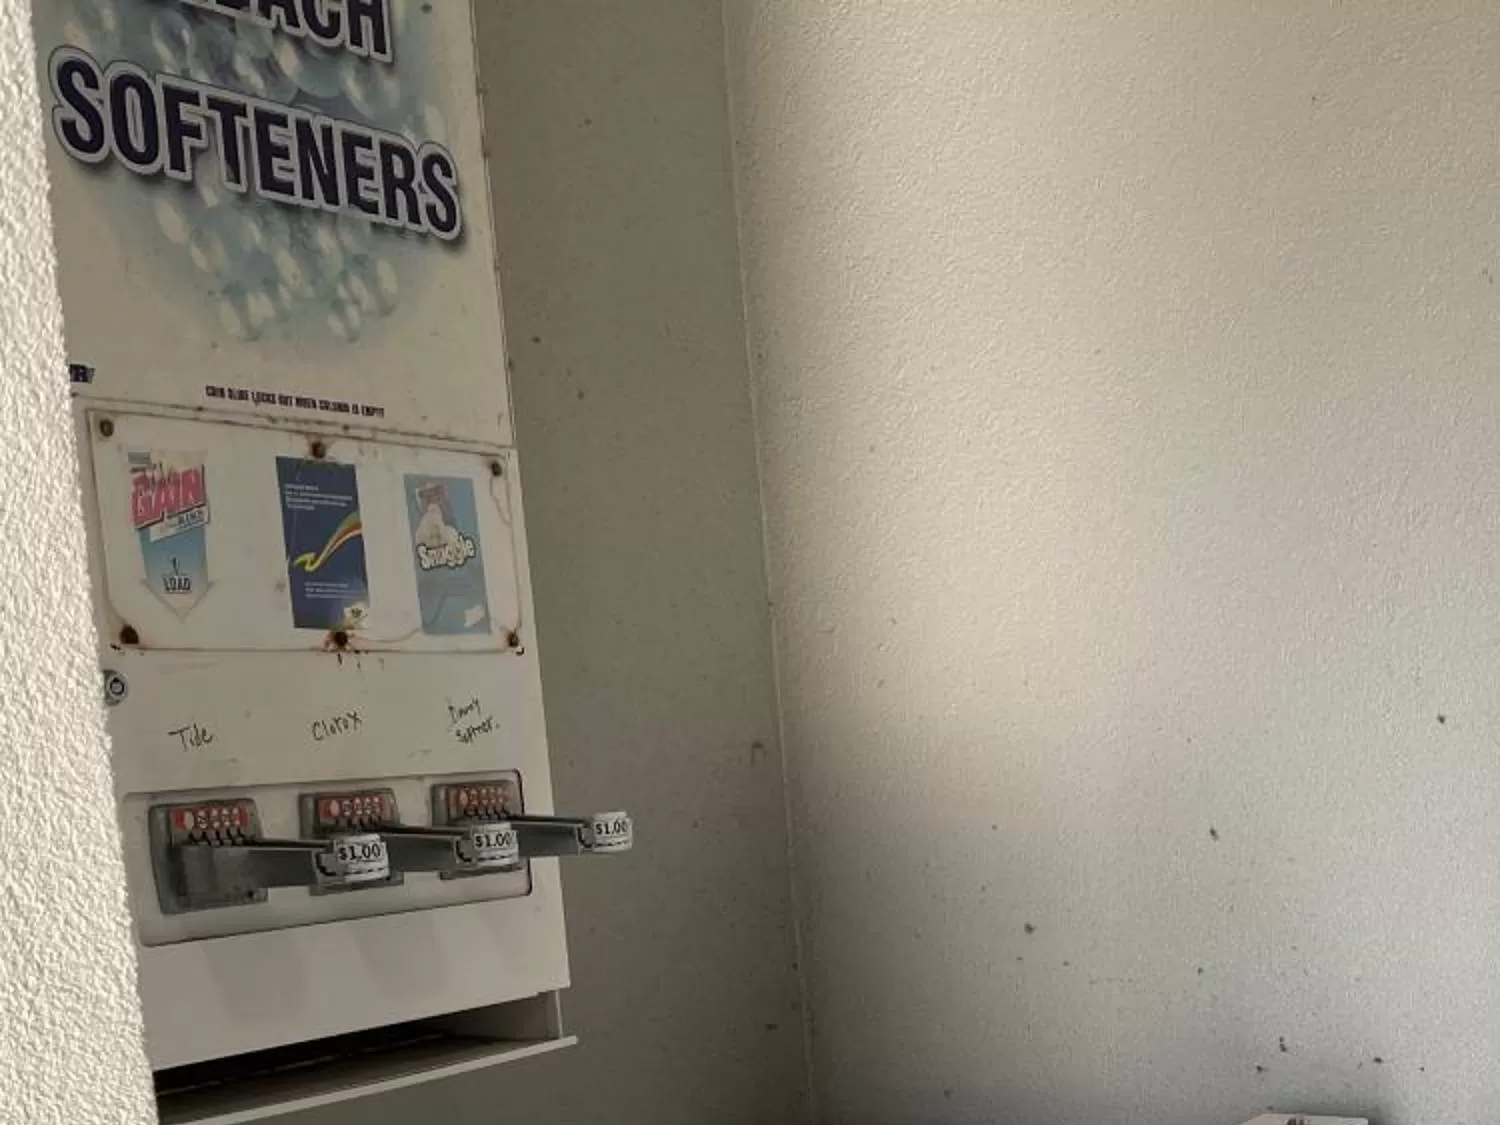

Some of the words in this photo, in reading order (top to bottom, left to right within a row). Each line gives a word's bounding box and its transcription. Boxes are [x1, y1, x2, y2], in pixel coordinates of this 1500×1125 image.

[53, 57, 460, 235] SOFTENERS
[163, 577, 191, 591] LOAD
[168, 722, 213, 751] Tide
[594, 818, 629, 835] $1.00
[474, 831, 511, 848] $1.00
[338, 841, 381, 861] $1.00
